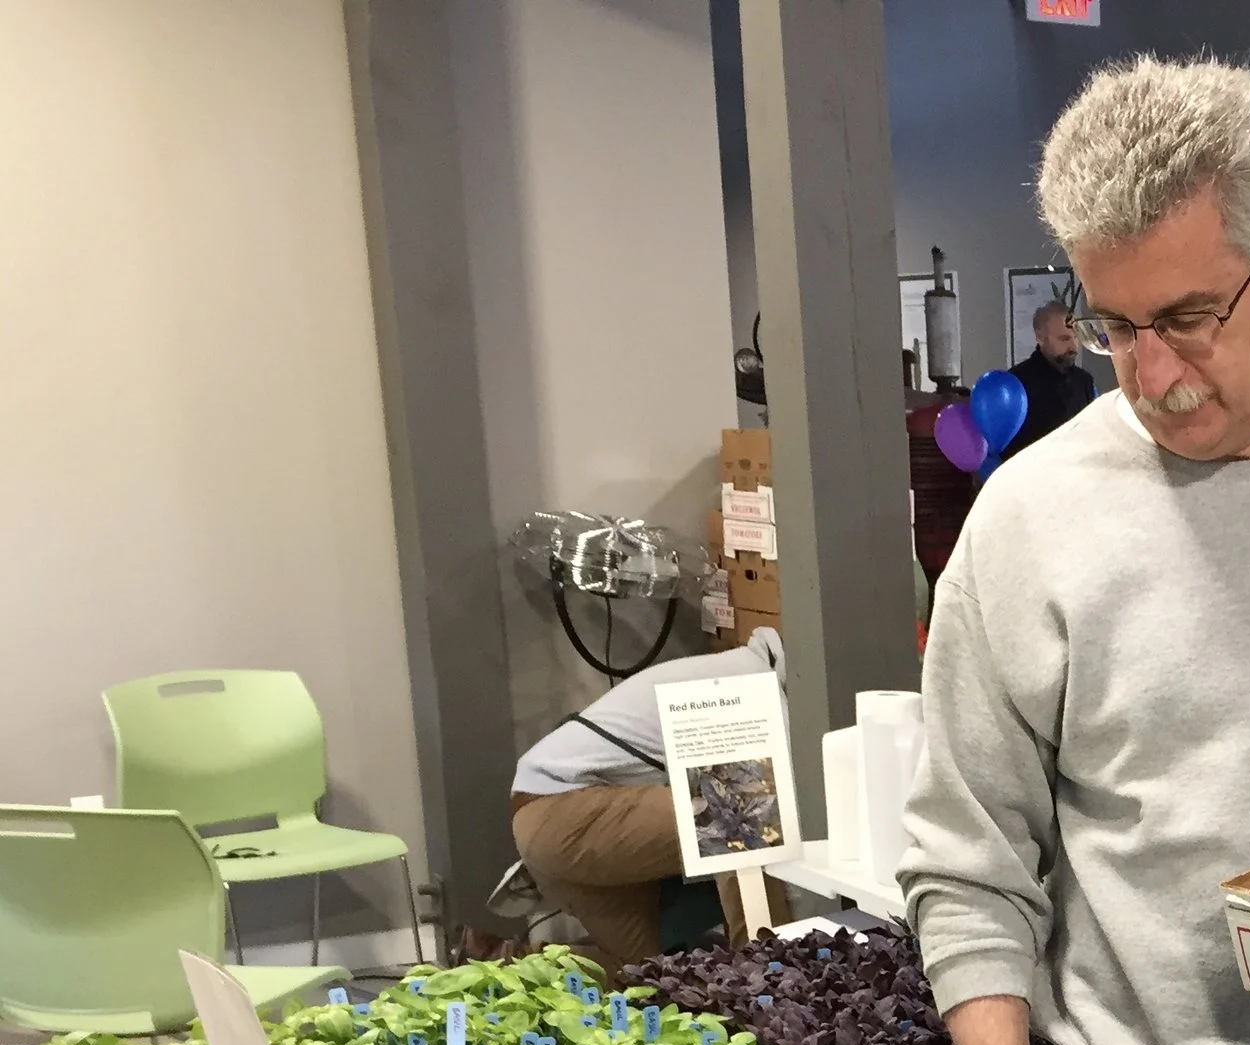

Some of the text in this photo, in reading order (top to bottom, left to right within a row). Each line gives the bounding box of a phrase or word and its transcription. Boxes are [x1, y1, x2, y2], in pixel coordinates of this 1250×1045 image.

[669, 696, 741, 713] Red Rubin Basil
